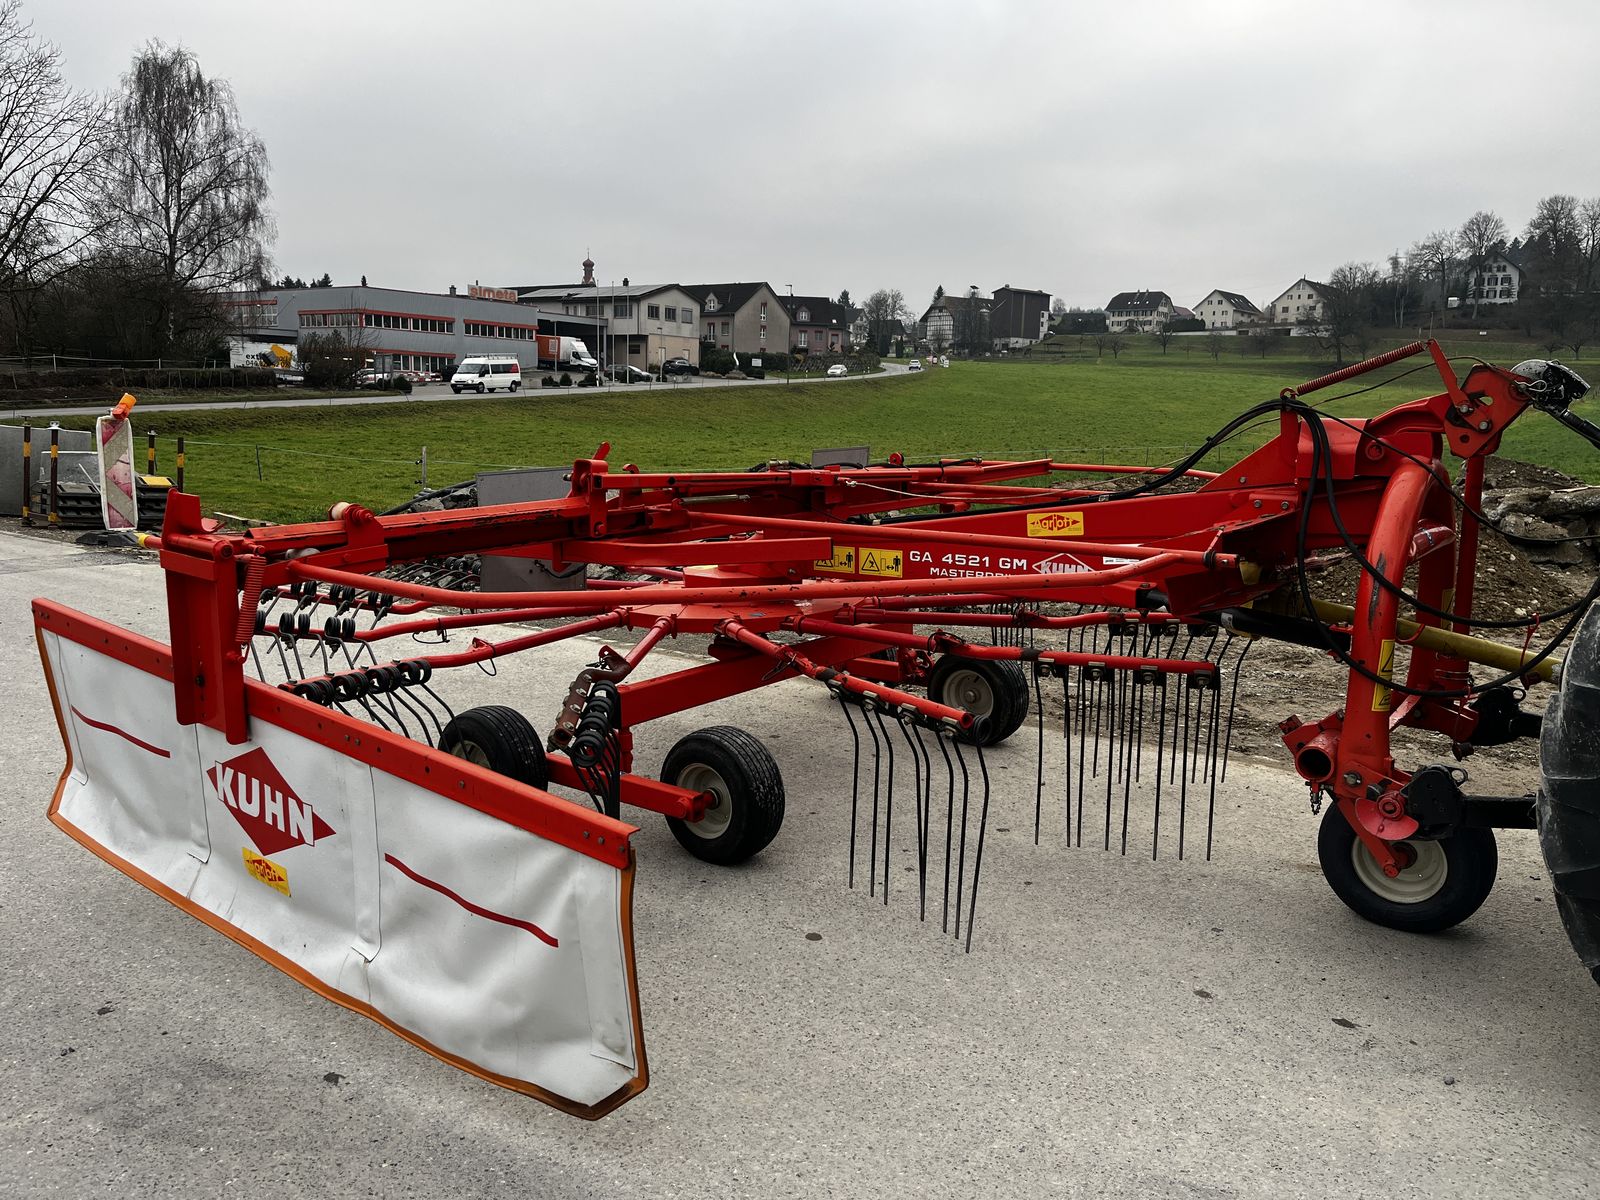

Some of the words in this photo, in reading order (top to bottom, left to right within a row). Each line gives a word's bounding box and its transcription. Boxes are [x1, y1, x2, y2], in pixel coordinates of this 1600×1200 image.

[909, 550, 933, 563] GA
[941, 553, 990, 568] 4521
[998, 557, 1028, 571] GM
[215, 760, 315, 847] KUHN
